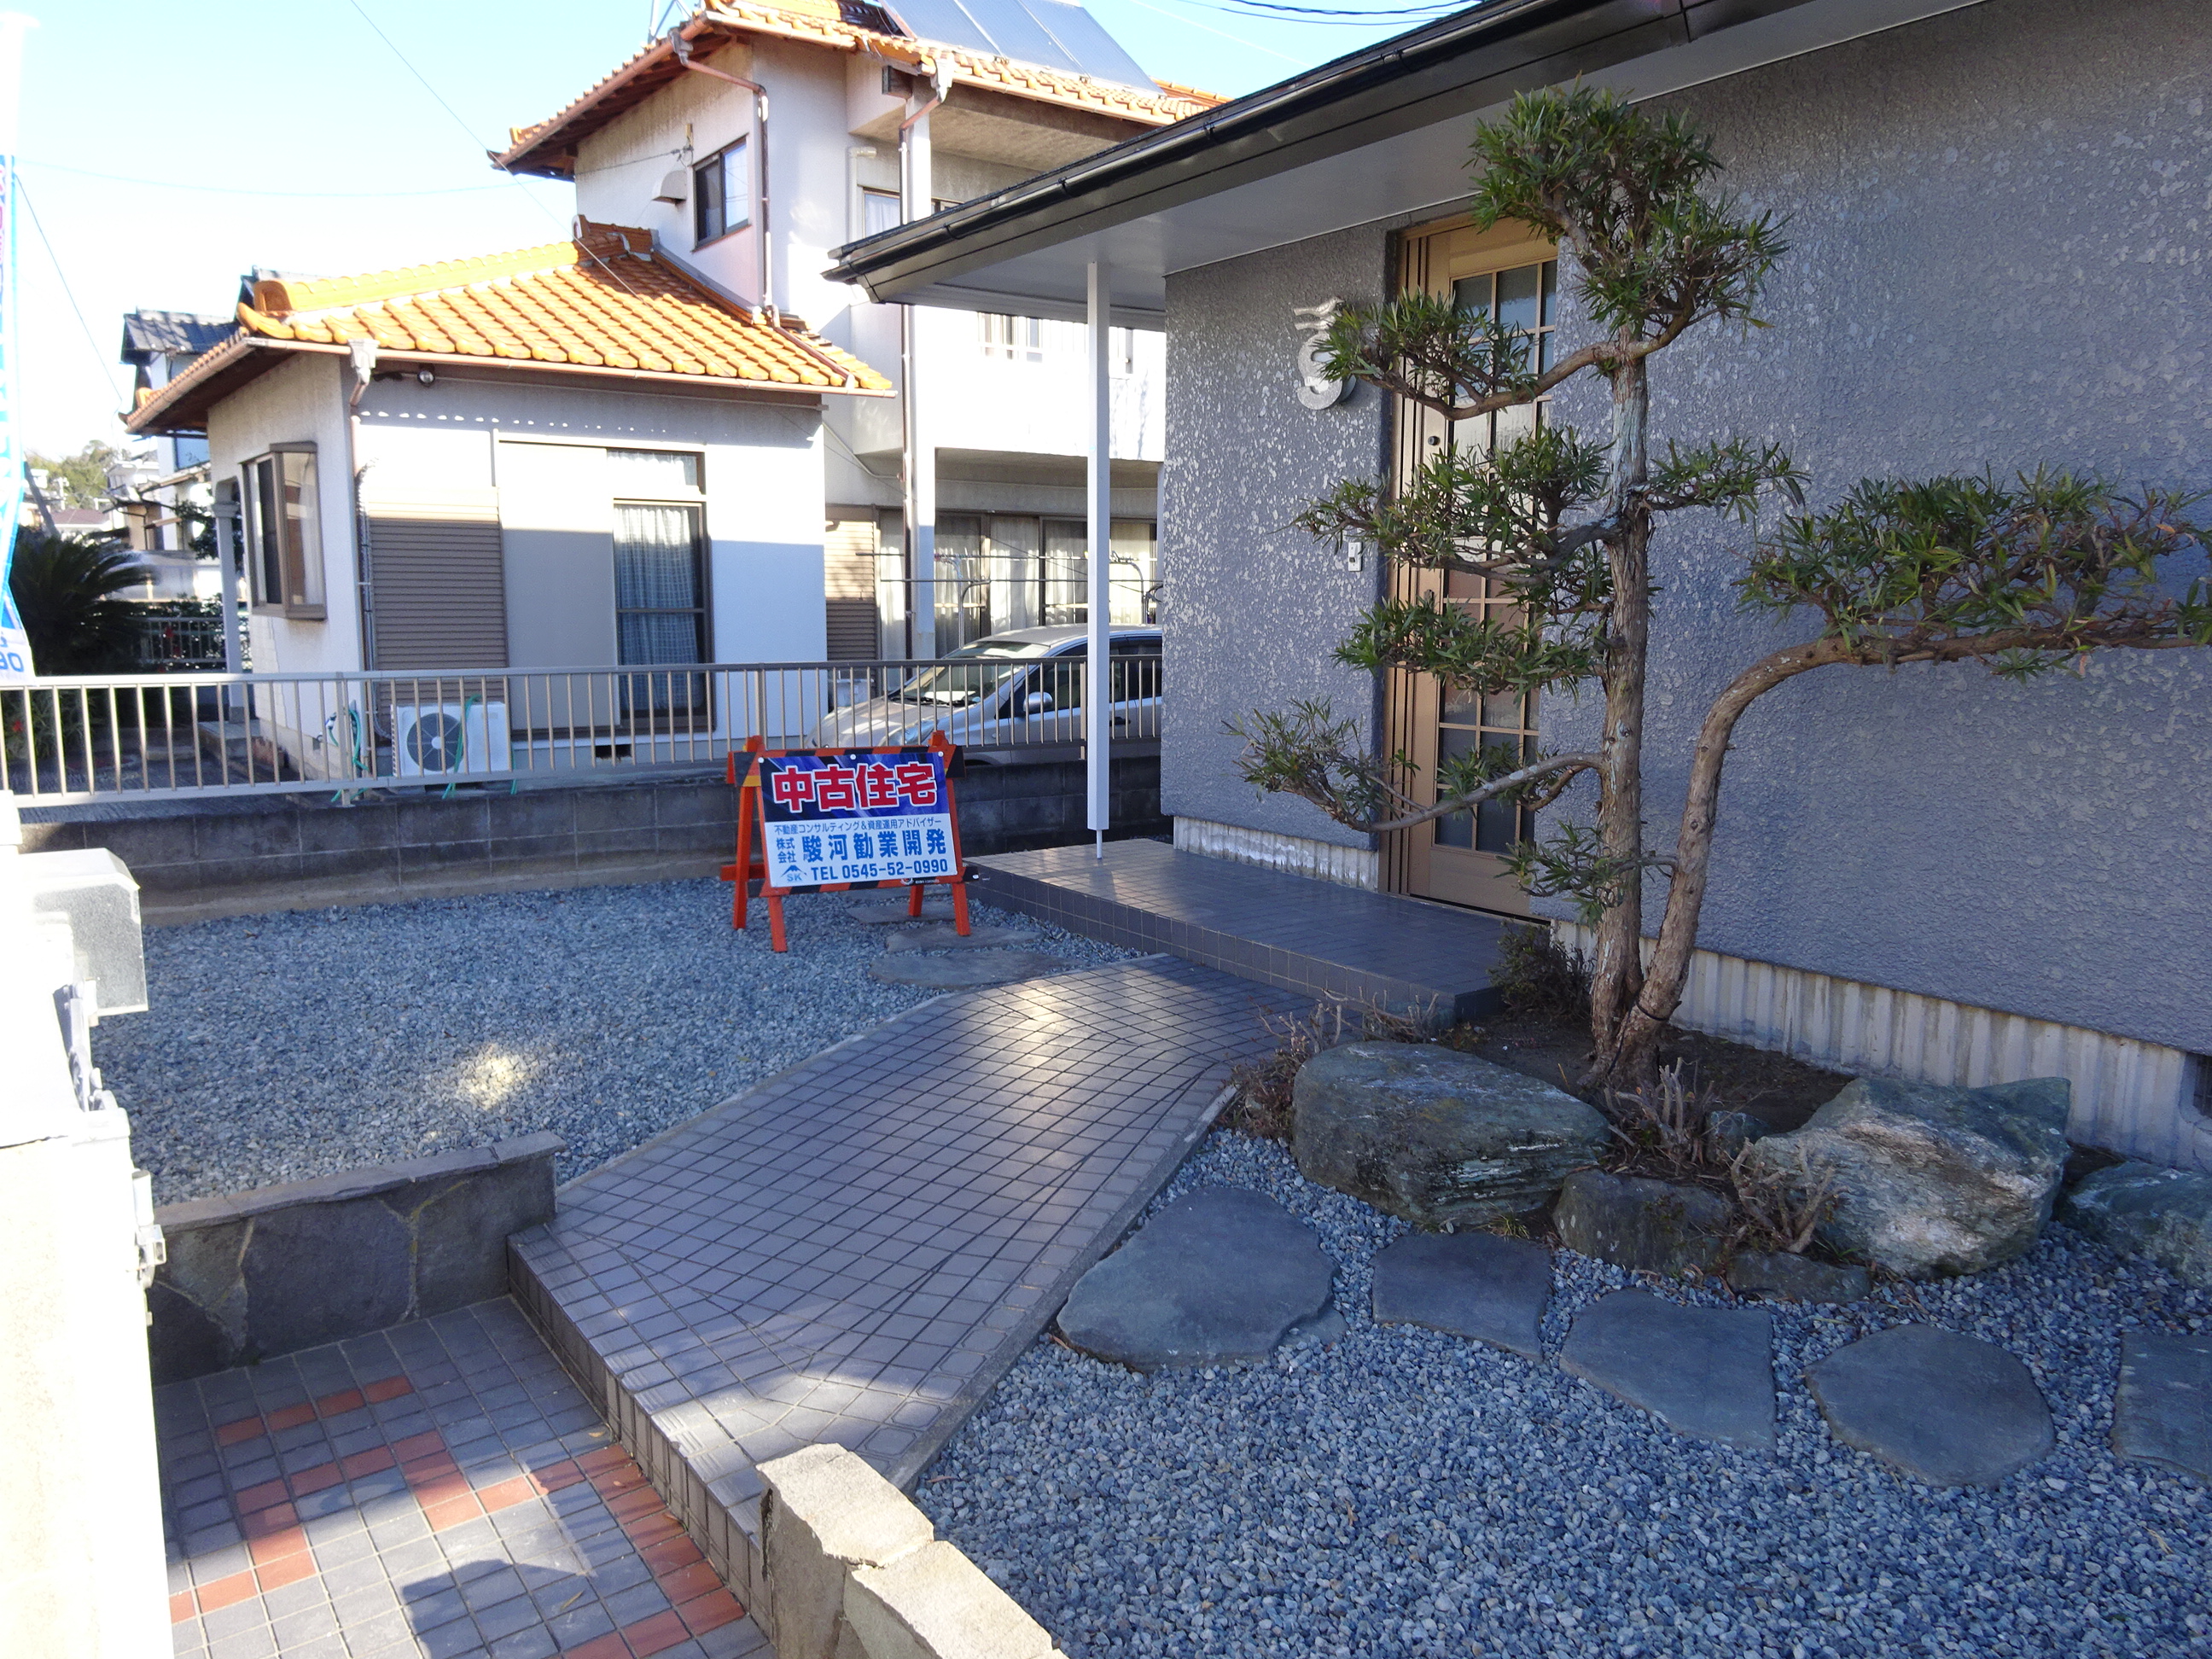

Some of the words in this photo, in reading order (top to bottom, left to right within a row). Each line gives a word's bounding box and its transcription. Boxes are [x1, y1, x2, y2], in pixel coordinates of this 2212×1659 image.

[771, 761, 937, 813] 中古住宅
[777, 837, 795, 850] 株式
[802, 828, 946, 863] 駿河勧業開発
[777, 851, 796, 864] 会社
[787, 873, 803, 882] SK
[811, 865, 838, 881] TEL
[841, 859, 948, 878] 0545-52-0990
